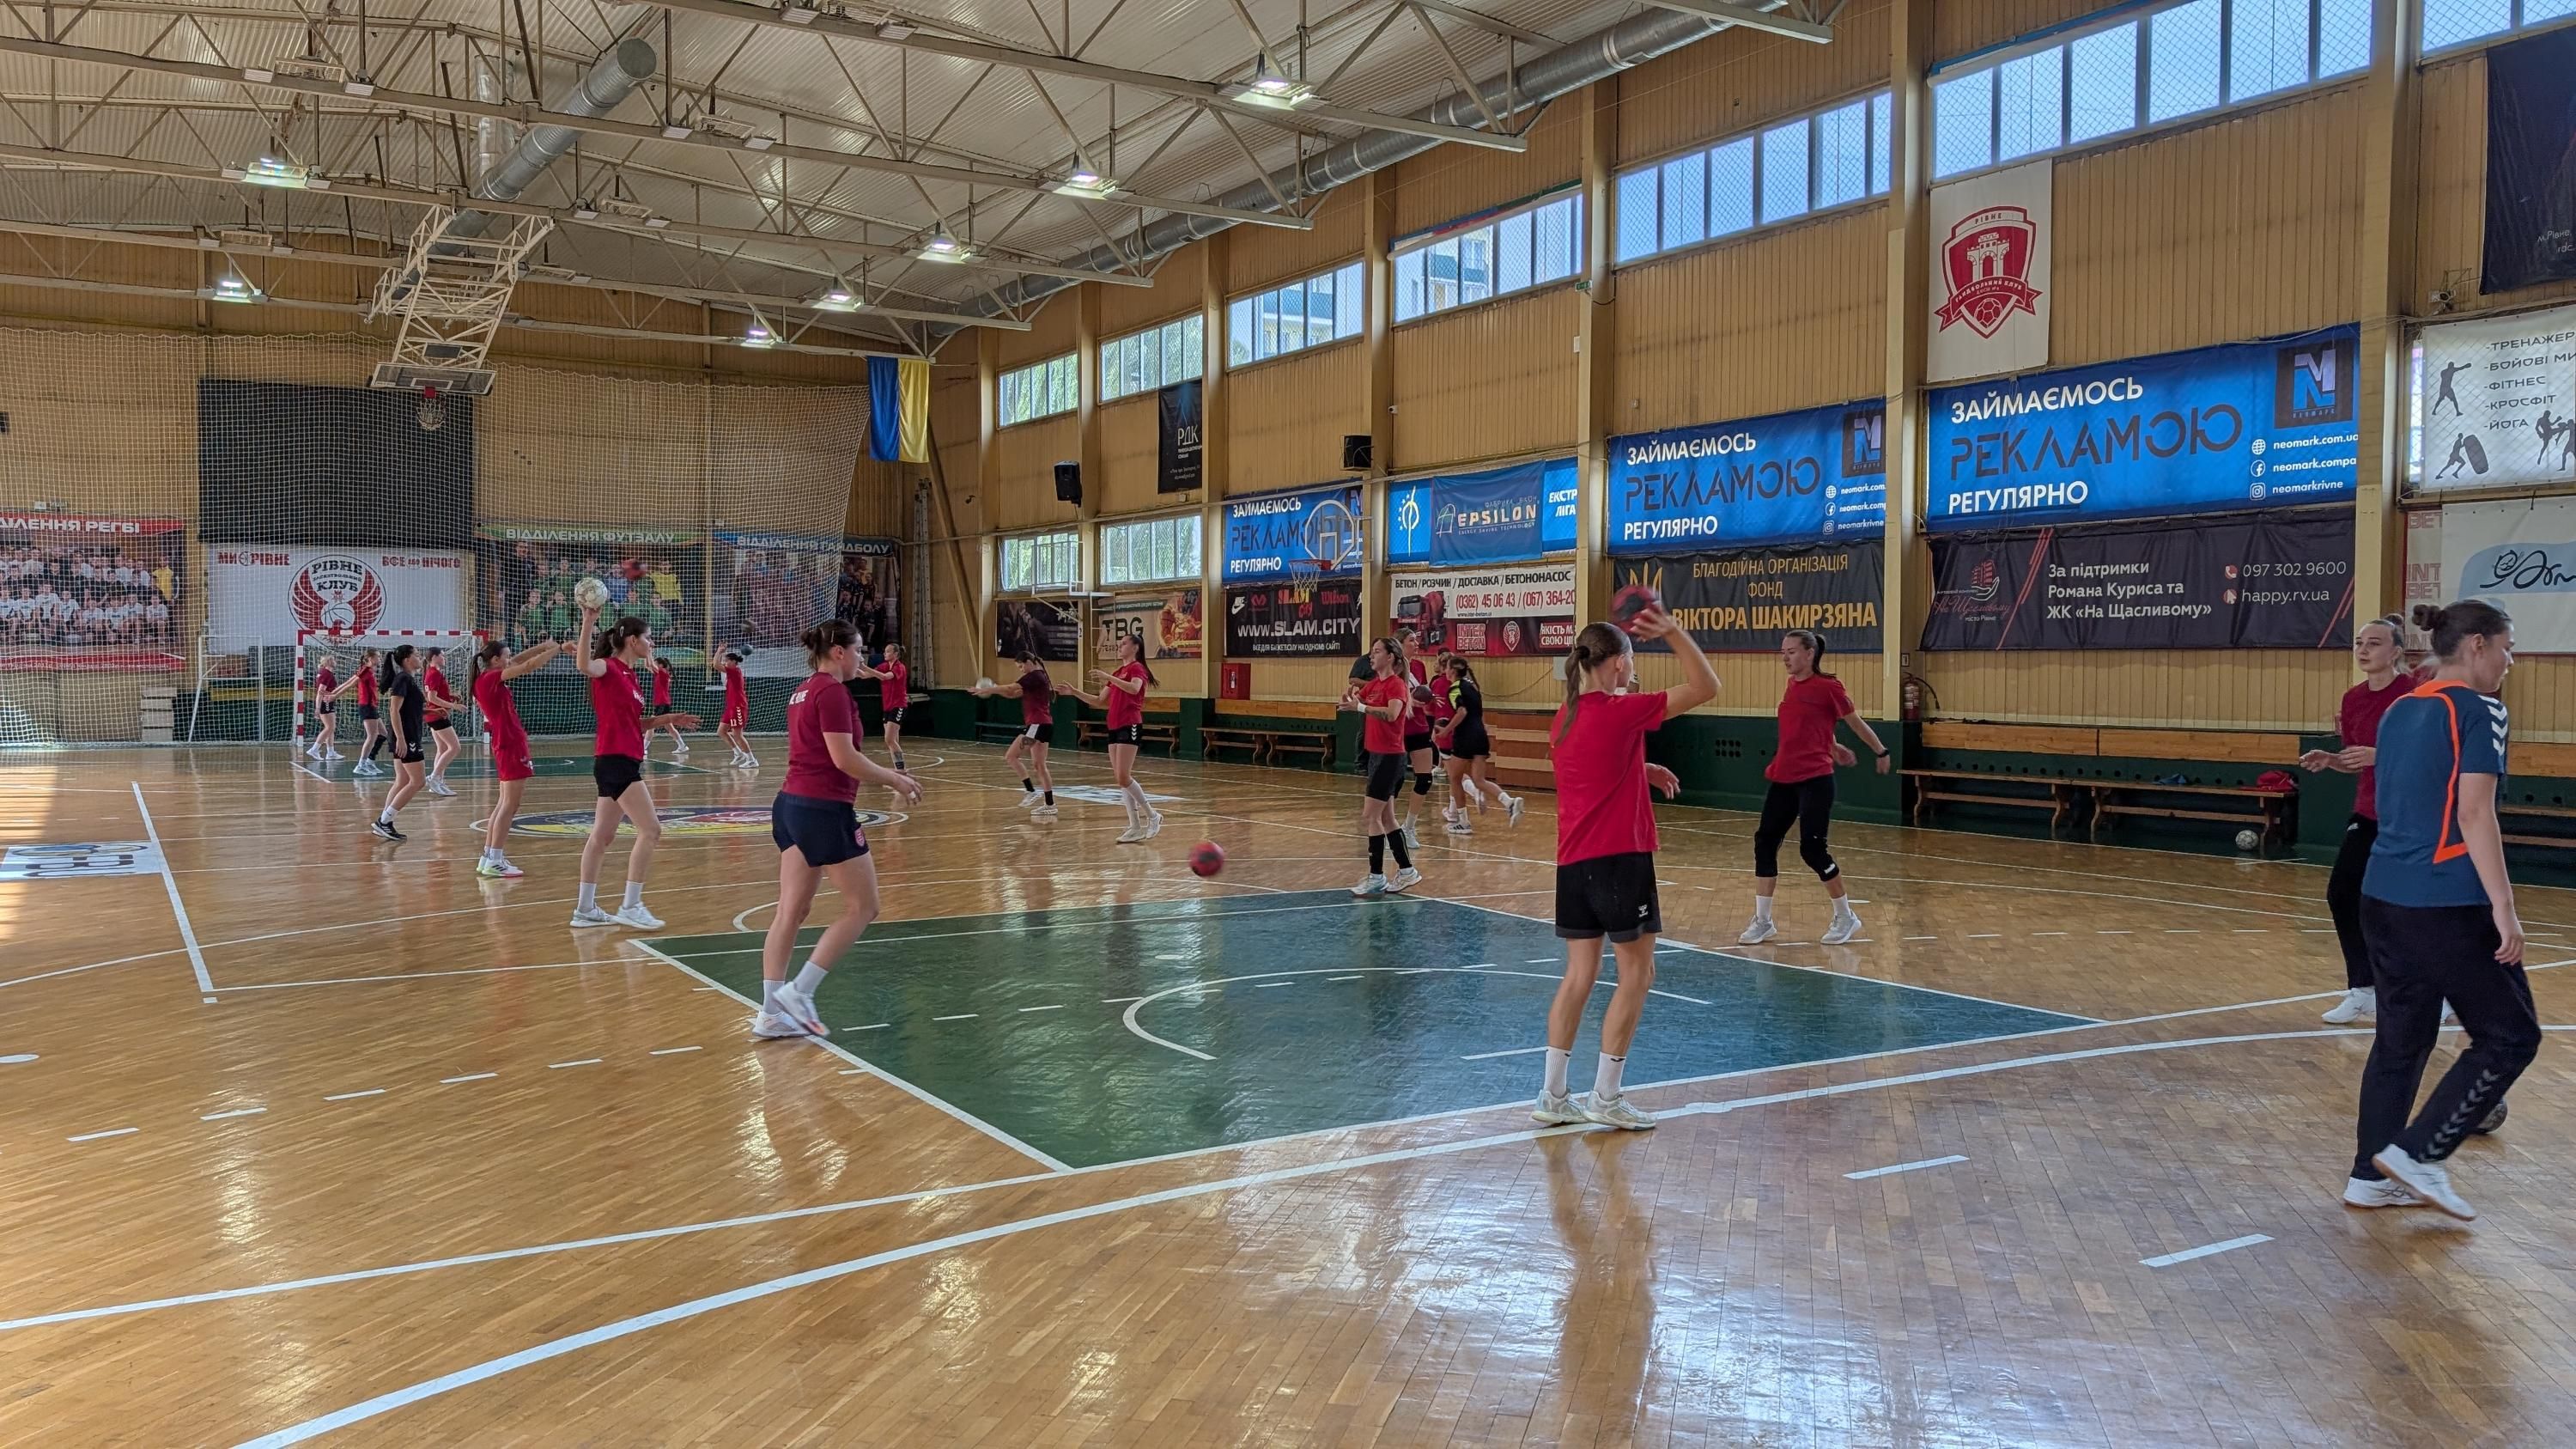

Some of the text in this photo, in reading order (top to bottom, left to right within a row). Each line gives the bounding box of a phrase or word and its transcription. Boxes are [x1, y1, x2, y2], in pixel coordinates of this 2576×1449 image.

[1975, 212, 2002, 225] РІВНЕ
[1955, 278, 2022, 303] ГАНДБОЛЬНИЙ КЛУБ
[1951, 376, 2143, 424] ЗАЙМАЄМОСЬ
[1177, 424, 1199, 446] РДК
[1950, 404, 2243, 481] РЕКЛАМОЮ
[1627, 432, 1757, 466] ЗАЙМАЄМОСЬ
[1625, 457, 1821, 512] РЕКЛАМОЮ
[2272, 480, 2343, 494] neomarkrivne
[1948, 481, 2088, 514] РЕГУЛЯРНО
[1232, 497, 1302, 518] ЗАЙМАЄМОСЬ
[1457, 503, 1537, 527] EPSILON
[1555, 505, 1577, 517] ЛІГА
[86, 521, 140, 533] РЕГБІ
[1624, 516, 1718, 540] РЕГУЛЯРНО
[1838, 519, 1884, 530] neomarkrivne
[506, 528, 675, 544] ВІДДІЛЕННЯ ФУТЗАЛУ
[737, 536, 818, 551] ВІДДІЛЕННЯ
[311, 560, 362, 575] РІВНЕ
[382, 556, 405, 567] ВСЕ
[1230, 557, 1282, 573] РЕГУЛЯРНО
[1692, 553, 1849, 580] БЛАГОДІЙНА ОРГАНІЗАЦІЯ
[2243, 561, 2347, 578] 097 302 9600
[1395, 579, 1418, 588] БЕТОН
[1422, 577, 1451, 588] РОЗЧИН
[1458, 575, 1499, 588] ДОСТАВКА
[1505, 570, 1571, 585] БЕТОНОНАСОС
[2048, 563, 2150, 580] За підтримки
[317, 580, 358, 593] КЛУБ
[1747, 581, 1783, 600] ФОНД
[2047, 582, 2184, 600] Романа Куриса та
[1278, 588, 1309, 605] SLAM
[1321, 591, 1350, 605] Wilson
[1455, 593, 1479, 612] (0362)
[1481, 593, 1492, 608] 45
[1493, 593, 1504, 608] 06
[1505, 592, 1516, 607] 43
[1522, 591, 1544, 610] (067)
[2241, 589, 2330, 606] happy.rv.ua
[1672, 602, 1878, 630] ВІКТОРА ШАКИРЗЯНА
[2046, 603, 2213, 620] ЖК «На Щасливому»
[1457, 624, 1485, 636] INTER
[1457, 637, 1486, 650] BETON
[1541, 636, 1563, 646] СВОЮ
